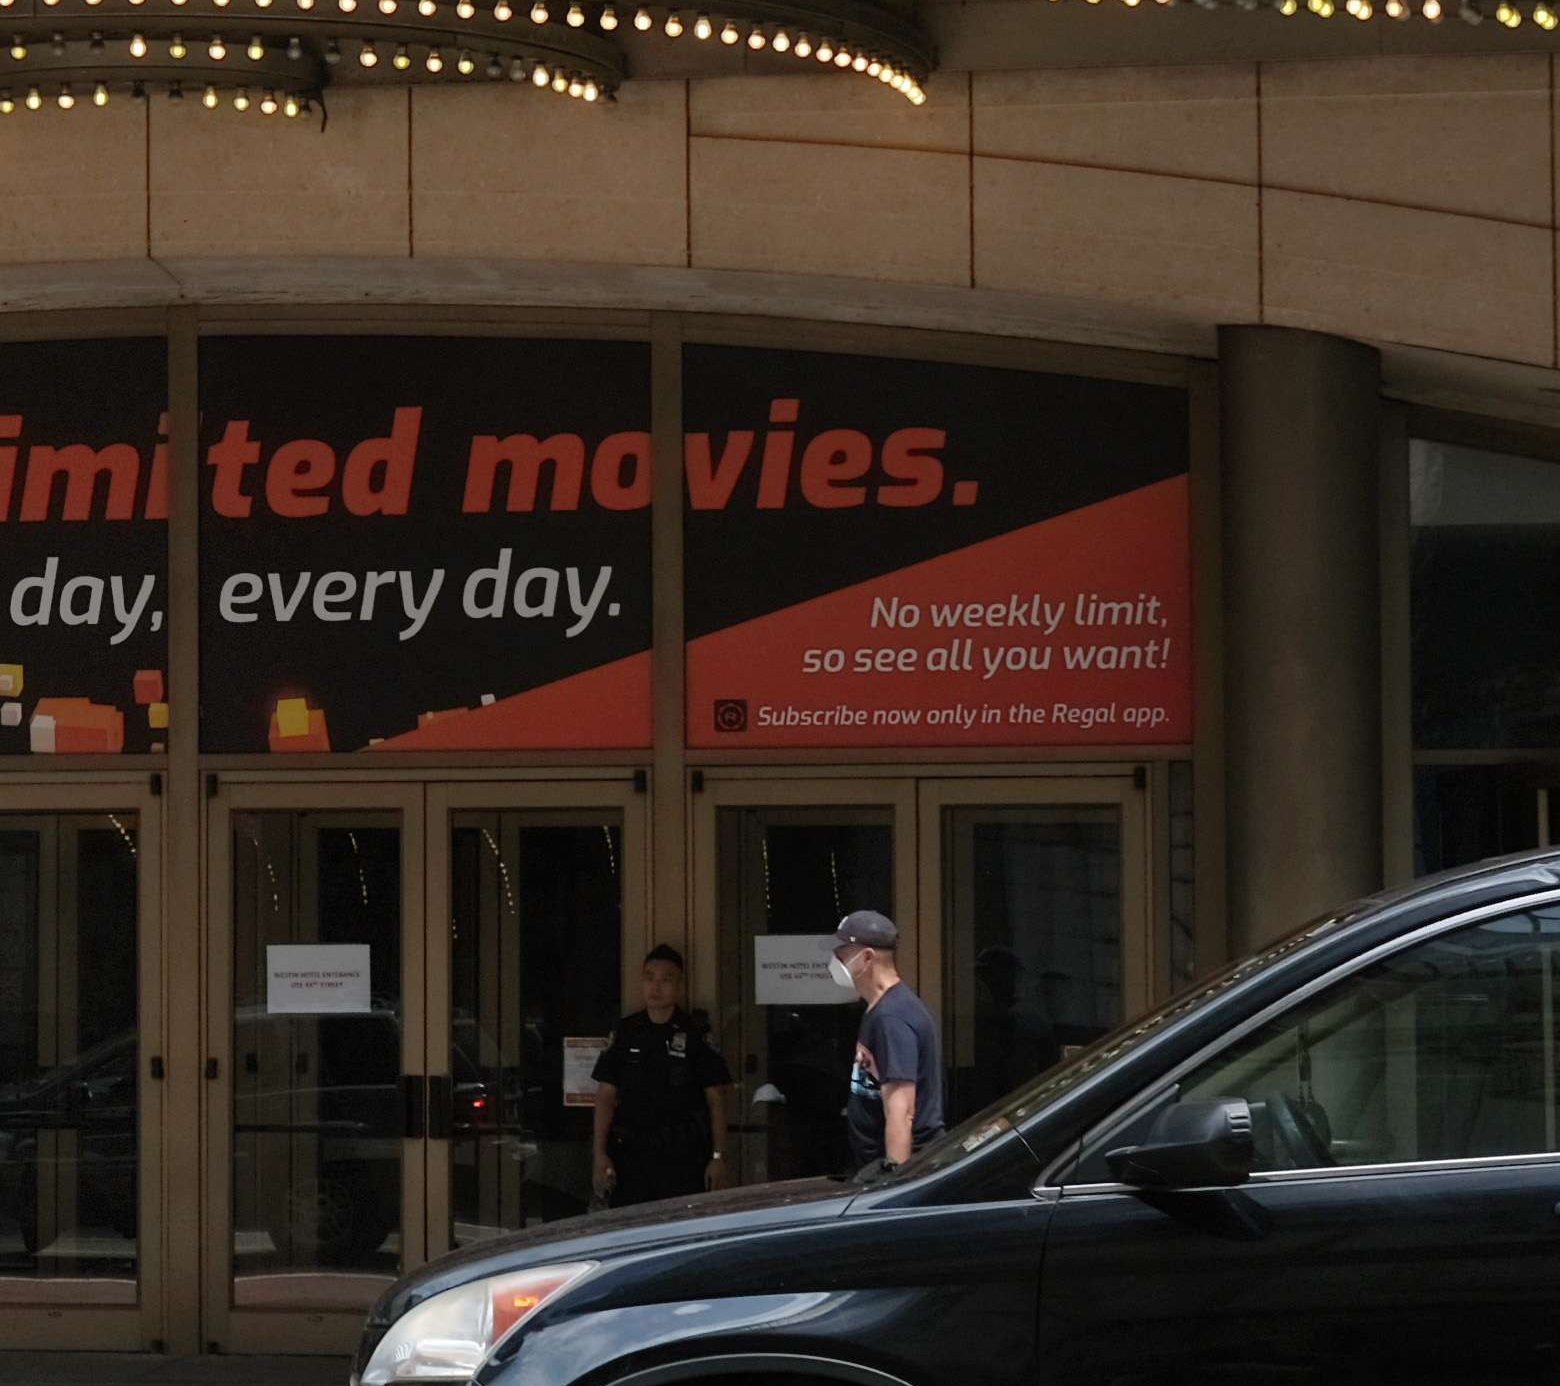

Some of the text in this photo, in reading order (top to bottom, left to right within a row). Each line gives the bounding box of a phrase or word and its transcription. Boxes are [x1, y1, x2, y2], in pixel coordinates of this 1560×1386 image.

[462, 398, 978, 513] movies.
[10, 557, 163, 645] day,
[219, 569, 445, 641] every
[462, 548, 621, 638] day.
[870, 593, 1169, 634] No weekly limit,
[802, 638, 1171, 678] so see all you want!
[758, 704, 868, 726] Subscribe
[873, 708, 921, 725] now
[927, 704, 976, 729] only
[982, 705, 1002, 724] in
[1009, 705, 1046, 724] the
[1052, 703, 1116, 729] Regal
[1123, 707, 1170, 729] app.
